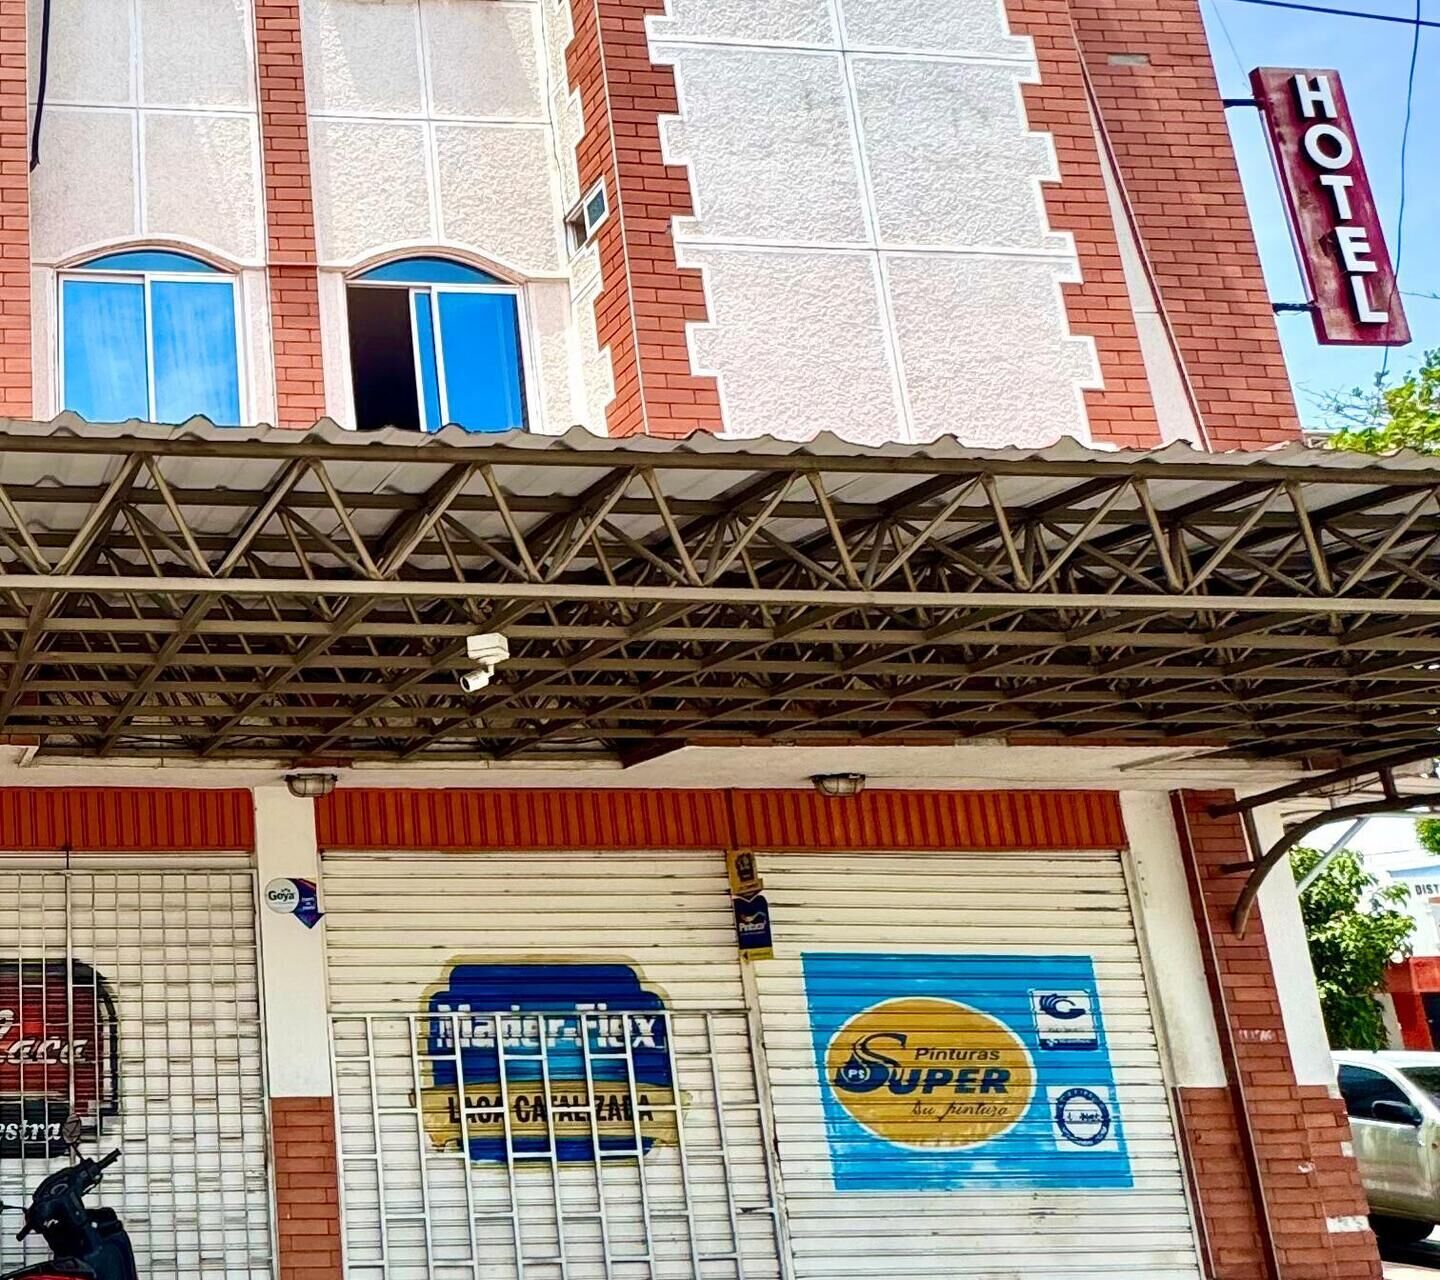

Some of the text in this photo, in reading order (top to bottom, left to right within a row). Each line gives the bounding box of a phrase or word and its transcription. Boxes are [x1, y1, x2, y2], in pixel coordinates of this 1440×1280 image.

[1293, 74, 1389, 324] HOTEL
[268, 889, 295, 902] Goya
[914, 1047, 1001, 1061] Pinturas
